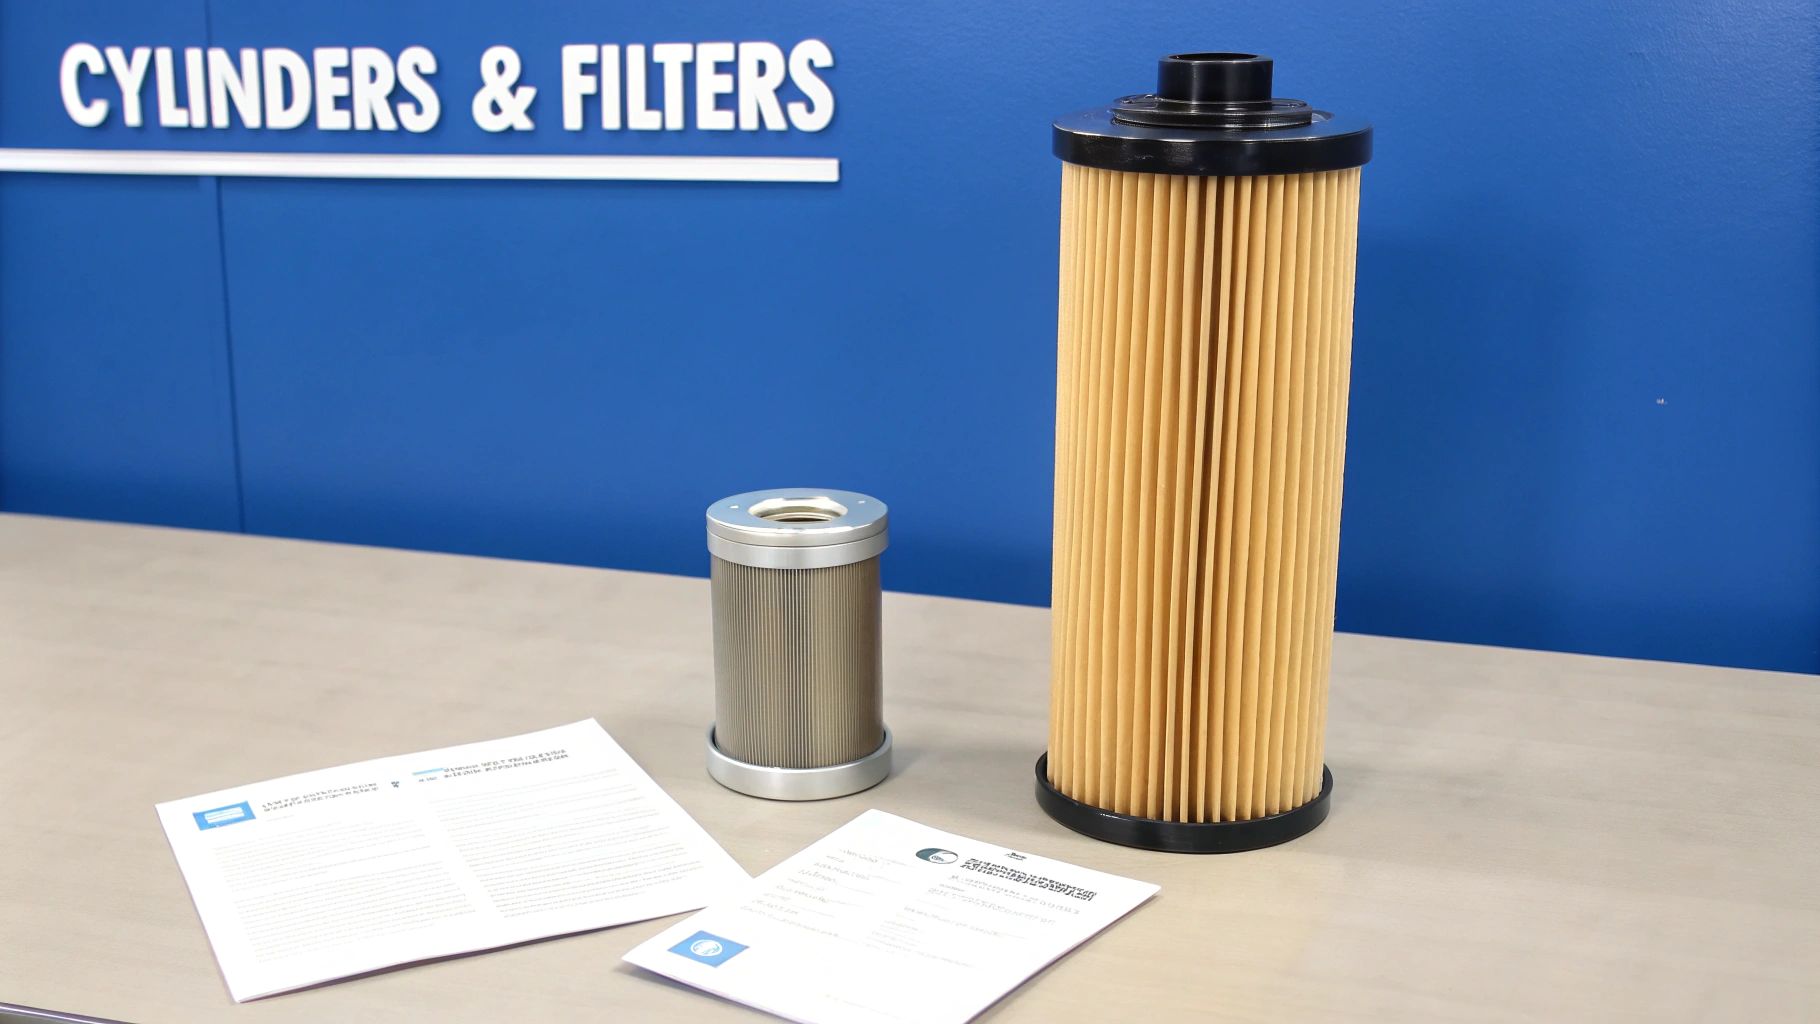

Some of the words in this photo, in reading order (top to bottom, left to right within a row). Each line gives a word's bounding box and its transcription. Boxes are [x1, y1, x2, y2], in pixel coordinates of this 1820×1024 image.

[59, 42, 440, 132] CYLINDERS
[472, 45, 536, 131] &
[561, 39, 836, 131] FILTERS
